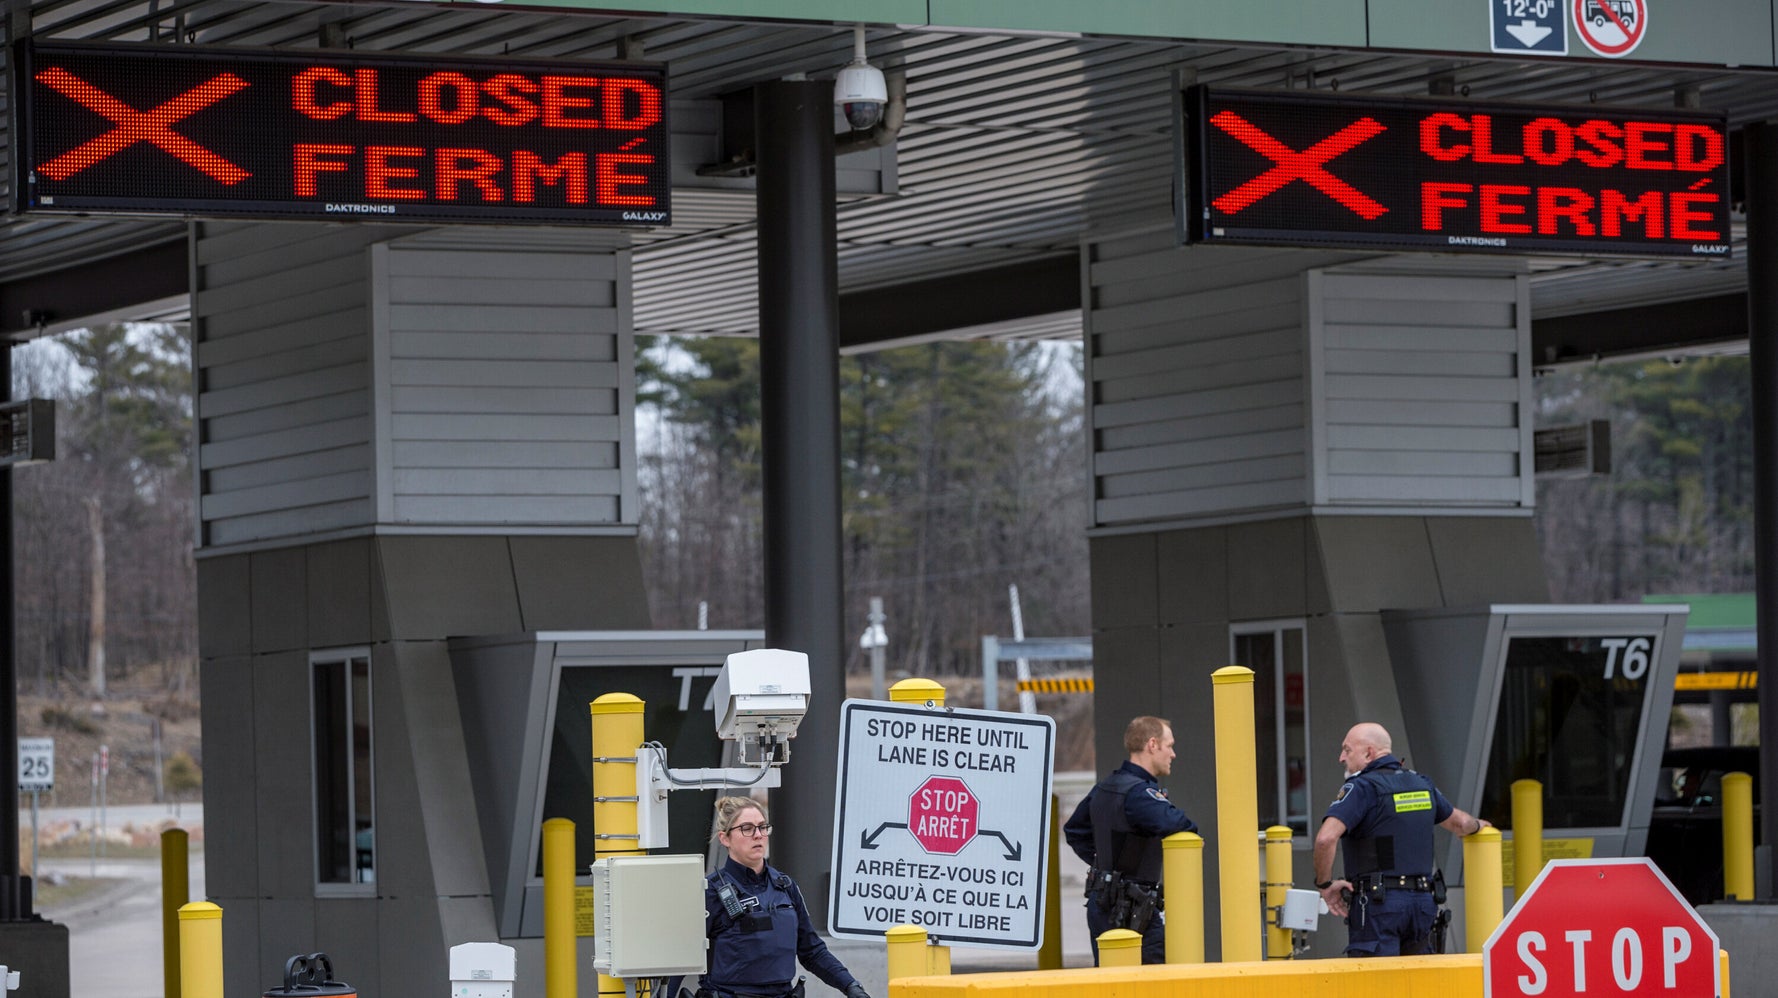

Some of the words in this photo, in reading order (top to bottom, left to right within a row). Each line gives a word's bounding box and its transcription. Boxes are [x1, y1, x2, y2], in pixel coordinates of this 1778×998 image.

[291, 66, 662, 131] CLOSED
[1420, 112, 1725, 172] CLOSED
[293, 137, 656, 206] FERMÉ
[325, 203, 396, 213] DAKTRONICS
[1421, 177, 1720, 240] FERMÉ
[1448, 236, 1507, 246] DAKTRONICS
[1600, 638, 1650, 680] T6
[867, 718, 916, 739] STOP
[922, 723, 972, 744] HERE
[977, 728, 1029, 750] UNTIL
[23, 756, 49, 778] 25
[878, 744, 927, 765] LANE
[932, 749, 949, 767] IS
[954, 751, 1016, 773] CLEAR
[920, 788, 969, 812] STOP
[917, 815, 970, 839] ARRÊT
[855, 858, 996, 885] ARRÊTEZ-VOUS
[1001, 870, 1024, 886] ICI
[847, 882, 927, 903] JUSQU'À
[932, 888, 957, 904] CE
[962, 890, 1000, 908] QUE
[1006, 894, 1029, 910] LA
[863, 906, 906, 924] VOIE
[911, 909, 953, 926] SOIT
[958, 913, 1011, 931] LIBRE
[1516, 926, 1692, 996] STOP
